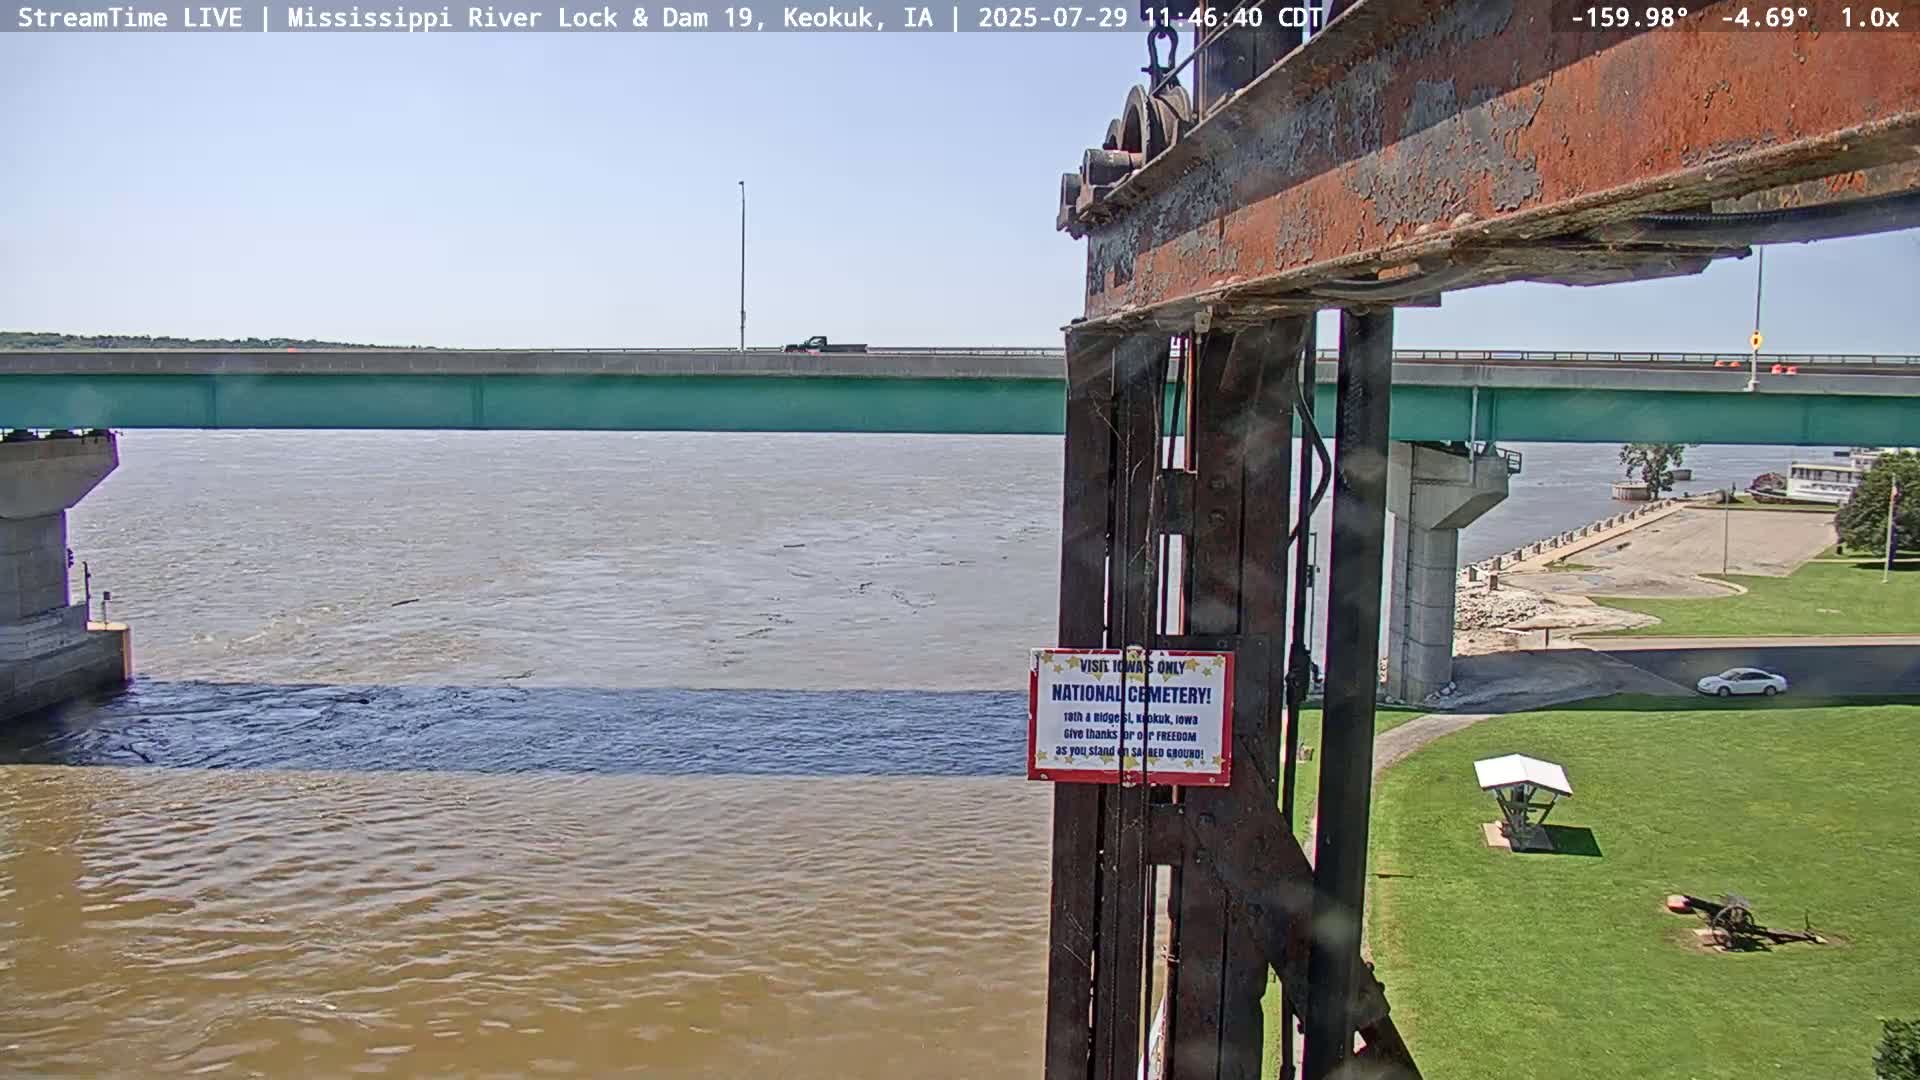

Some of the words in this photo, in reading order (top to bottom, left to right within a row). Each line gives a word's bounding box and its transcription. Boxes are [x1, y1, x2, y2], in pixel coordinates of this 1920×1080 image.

[1080, 659, 1109, 673] VISIT
[1157, 660, 1186, 675] ONLY
[1052, 684, 1122, 702] NATIONAL
[1128, 686, 1212, 704] CEMETERY!
[1094, 712, 1120, 724] Ridge
[1136, 712, 1174, 725] Kokuk,
[1175, 714, 1198, 725] Iowa
[1064, 728, 1084, 739] Give
[1086, 728, 1118, 739] thanks
[1120, 730, 1135, 740] or
[1137, 731, 1155, 741] or
[1157, 731, 1197, 742] FREEDOM
[1056, 746, 1068, 756] as
[1070, 746, 1087, 758] you
[1088, 746, 1115, 757] stand
[1131, 747, 1164, 758] SARED
[1166, 749, 1204, 760] GROUND!
